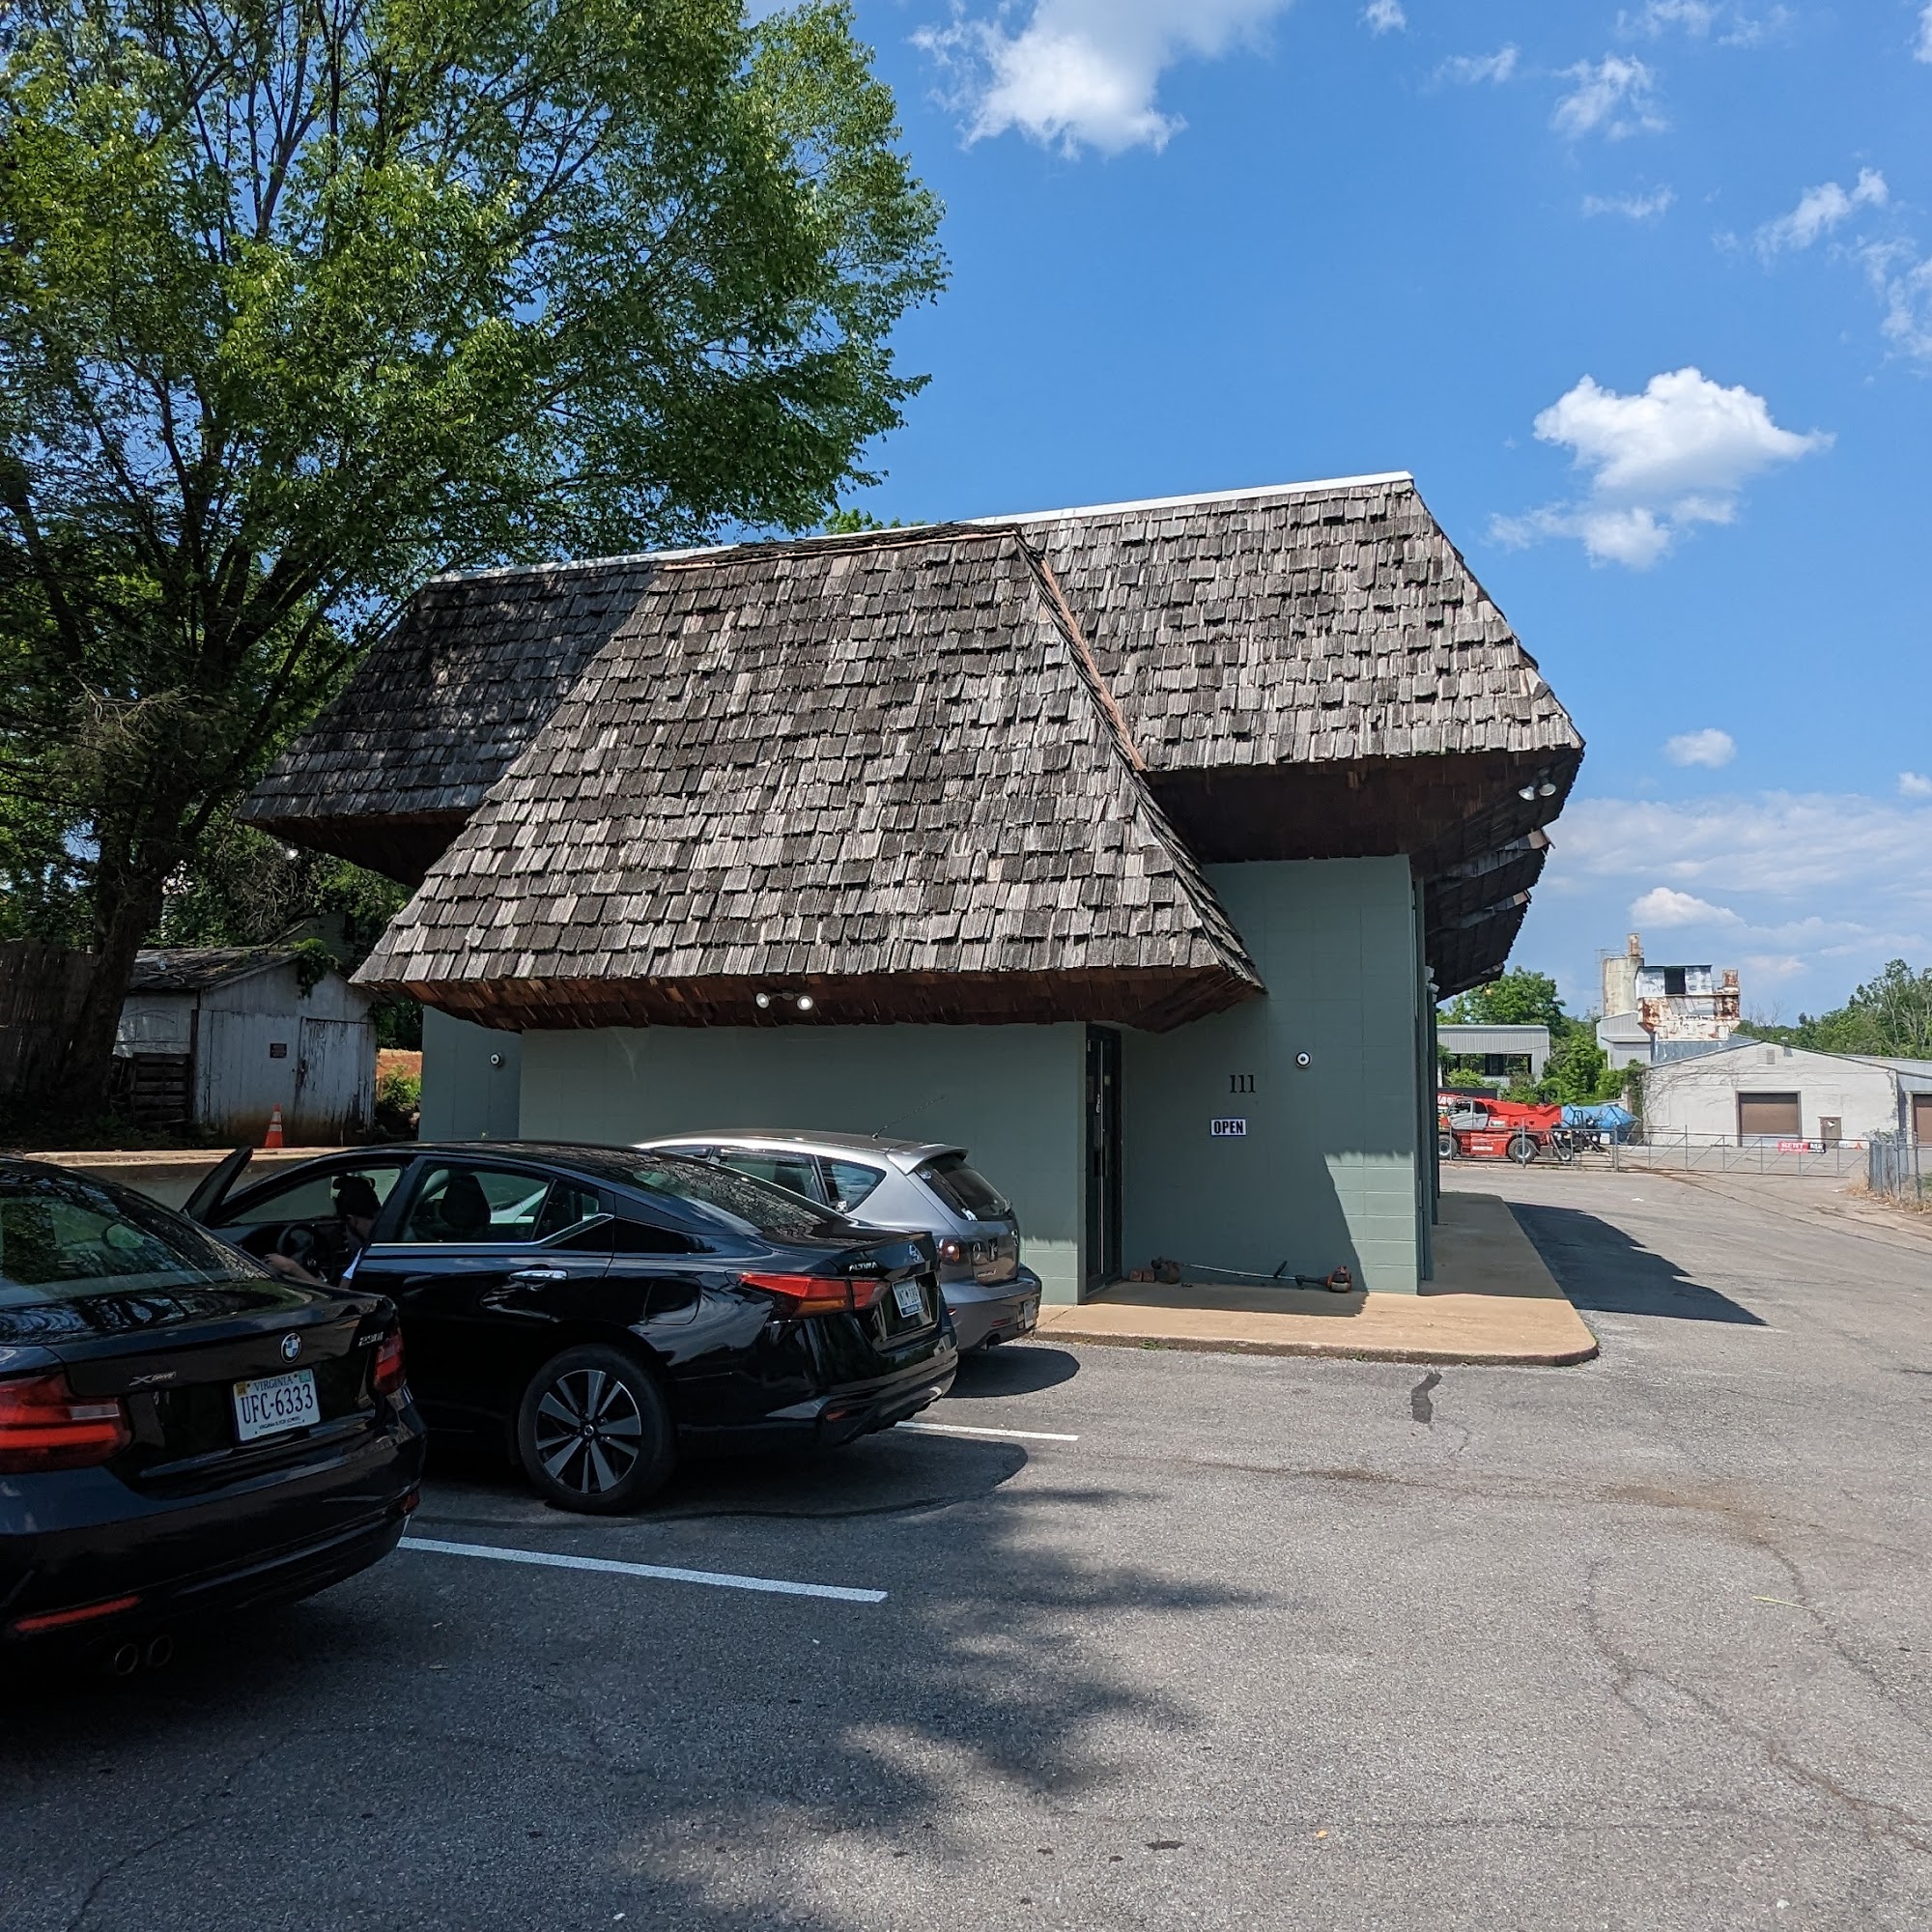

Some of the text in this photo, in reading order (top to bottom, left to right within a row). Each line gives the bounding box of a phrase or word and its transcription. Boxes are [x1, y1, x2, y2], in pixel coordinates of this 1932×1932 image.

[1229, 1074, 1256, 1094] 111
[1213, 1121, 1244, 1134] OPEN
[253, 1376, 294, 1392] VIRGINIA
